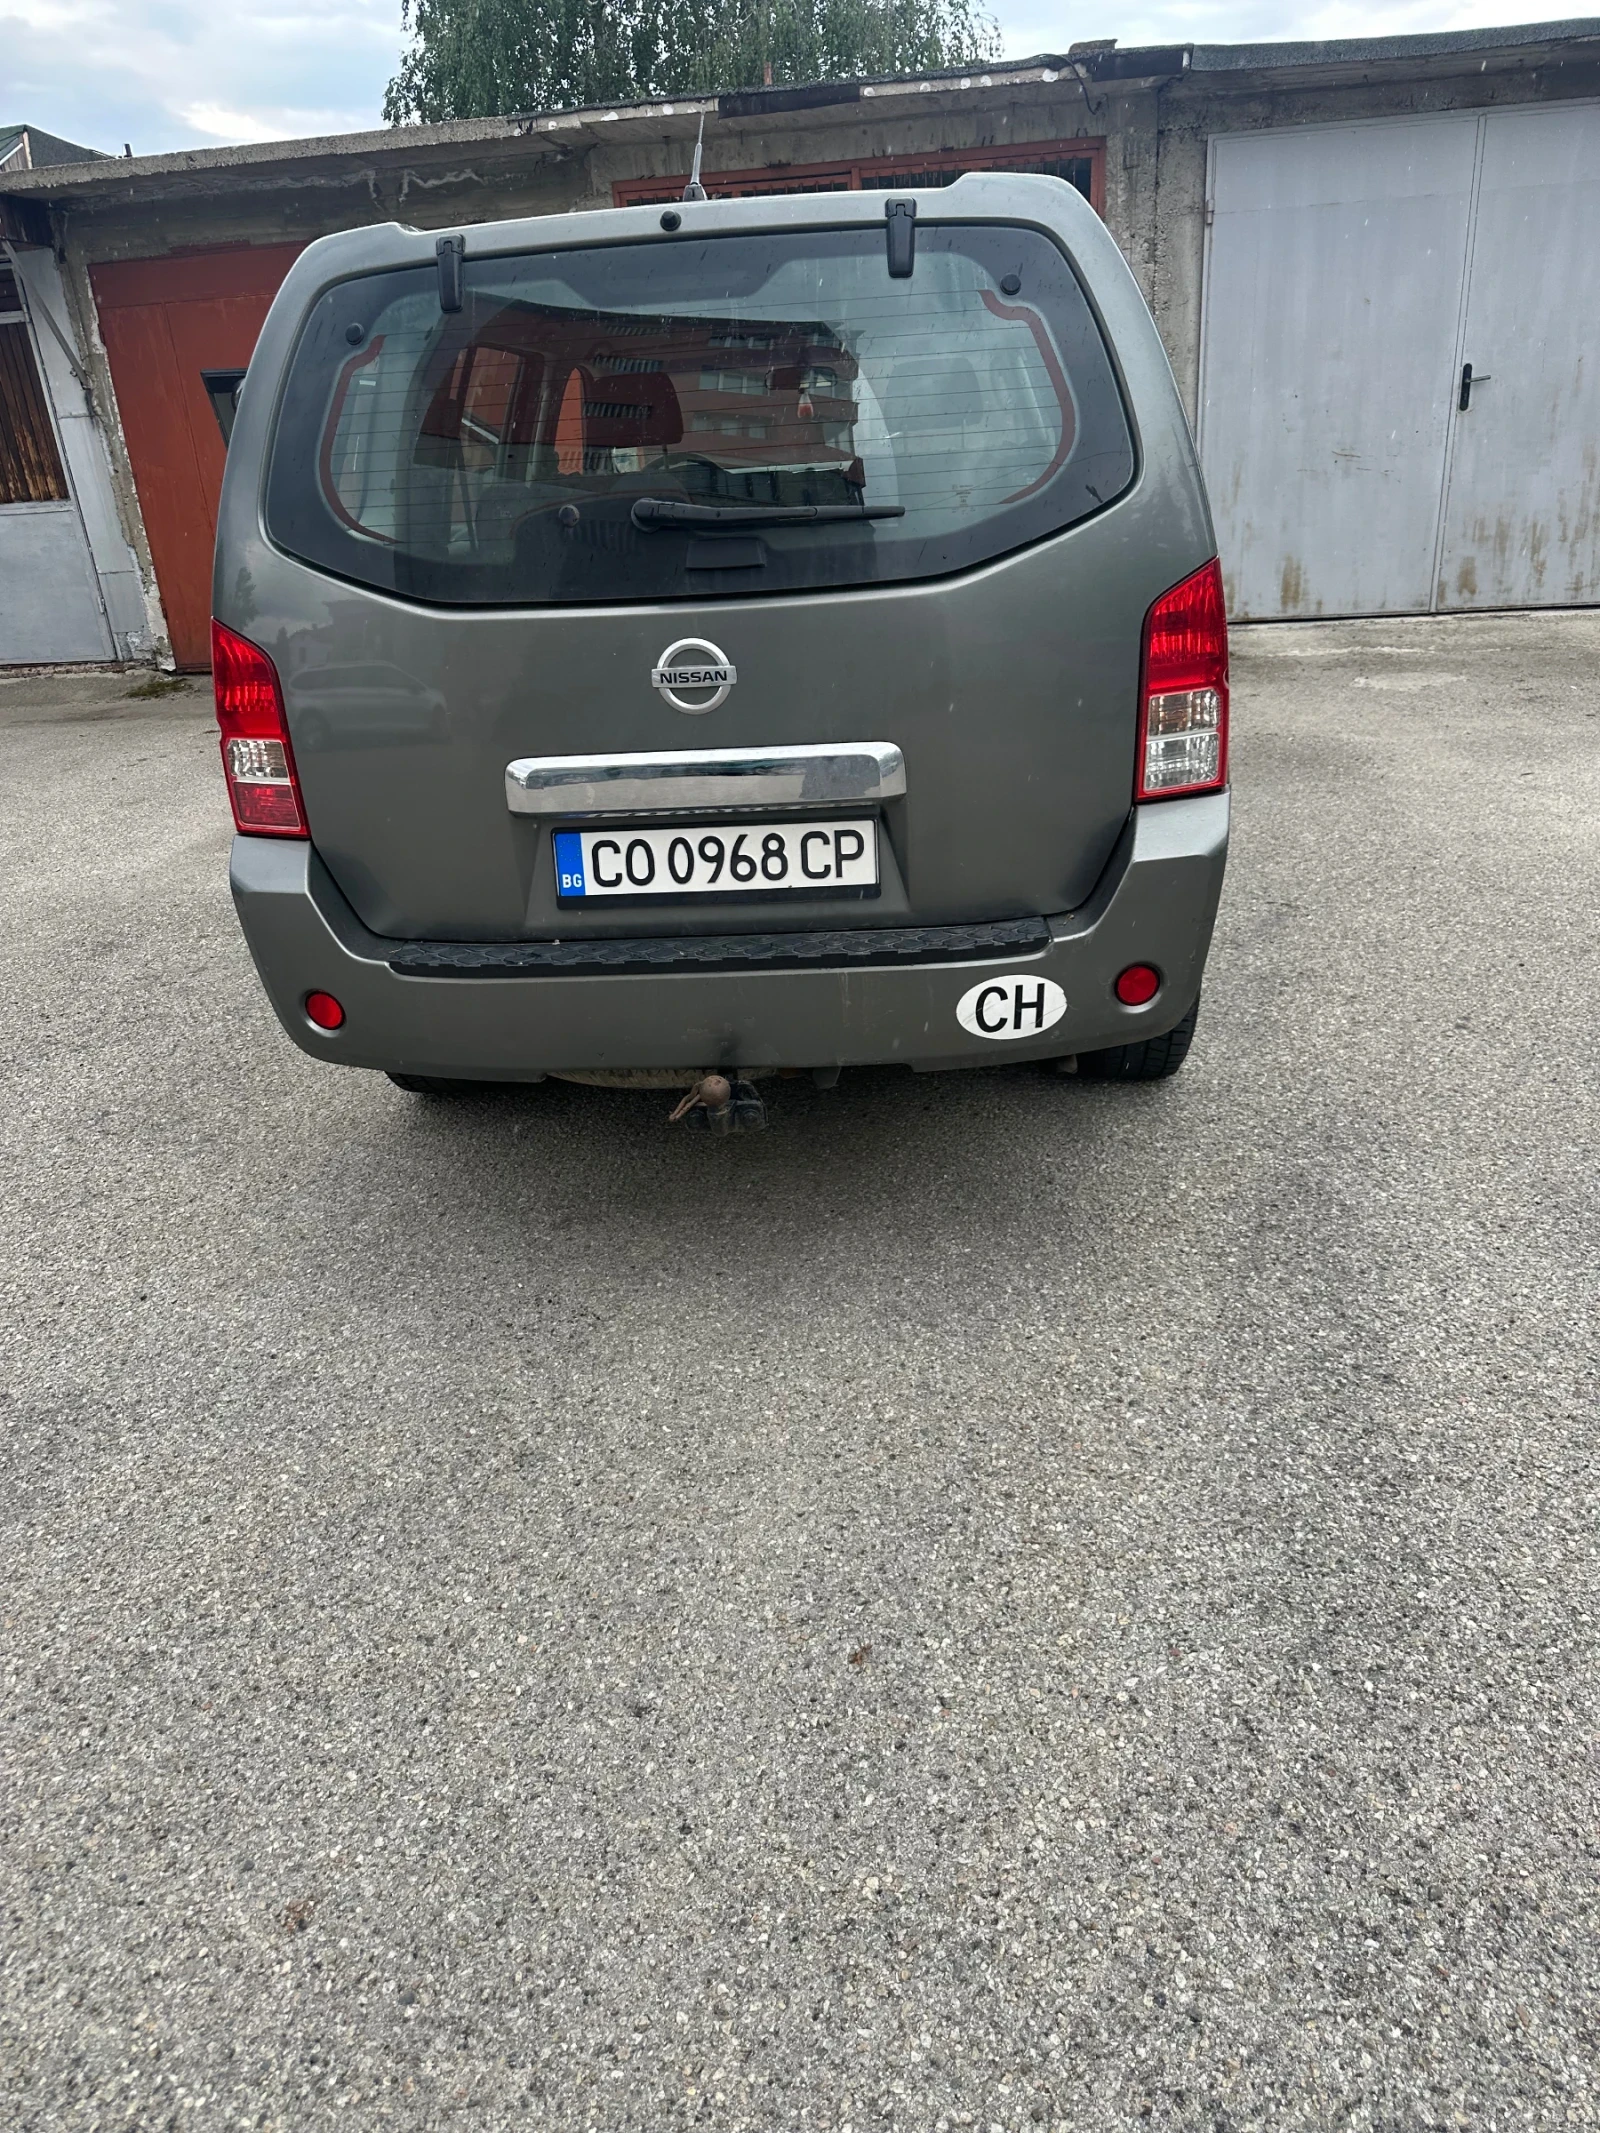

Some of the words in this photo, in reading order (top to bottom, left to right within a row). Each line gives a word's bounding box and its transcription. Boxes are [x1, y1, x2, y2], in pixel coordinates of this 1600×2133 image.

[660, 670, 728, 684] NISSAN
[591, 838, 656, 888] CO
[668, 833, 789, 885] 0968
[800, 829, 865, 879] CP
[562, 874, 583, 889] BG
[975, 983, 1046, 1033] CH
